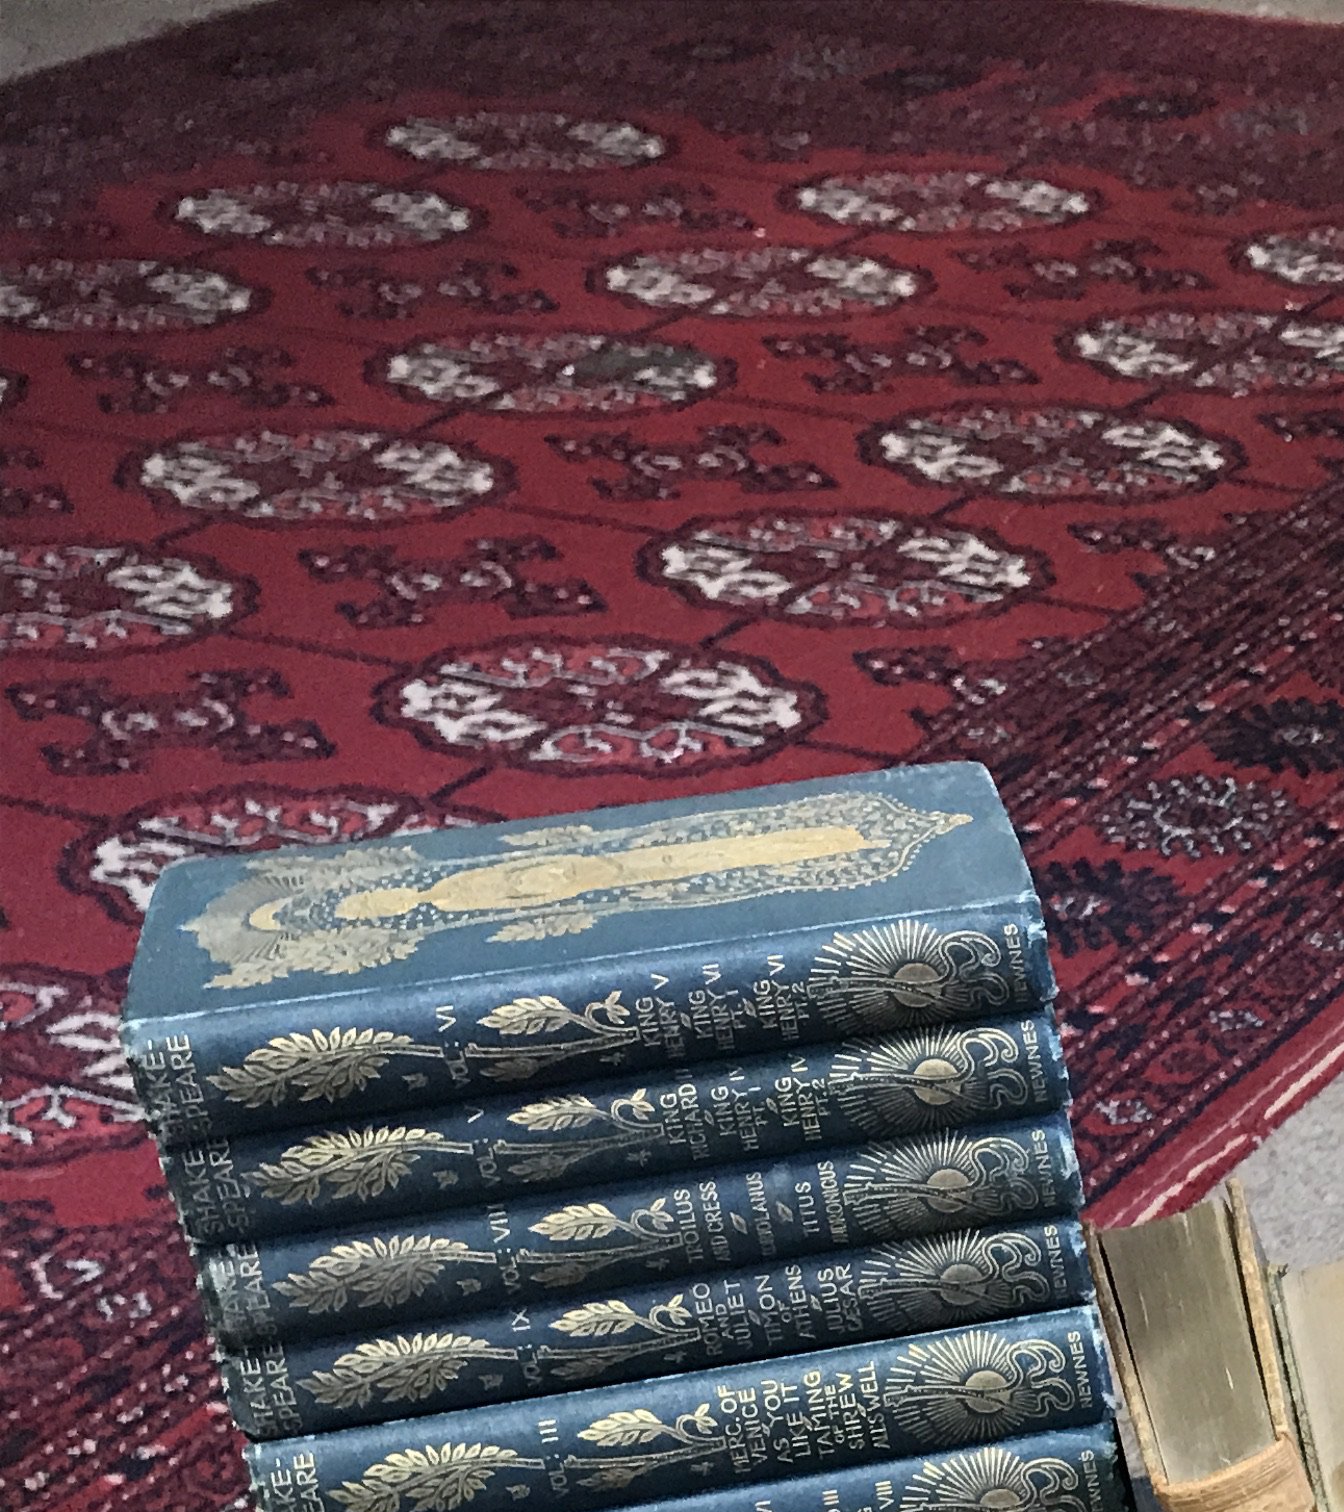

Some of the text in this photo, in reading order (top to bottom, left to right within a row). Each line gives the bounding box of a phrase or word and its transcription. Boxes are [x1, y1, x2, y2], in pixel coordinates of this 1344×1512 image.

[436, 1005, 457, 1031] VI
[636, 997, 660, 1047] KING
[650, 973, 686, 1058] HENRY V
[688, 990, 714, 1039] KING
[701, 963, 735, 1050] HENRY VI
[753, 979, 778, 1029] KING
[767, 954, 799, 1041] HENRY VI
[1020, 1020, 1048, 1102] NEWNES
[660, 1093, 686, 1144] KING
[711, 1085, 737, 1136] KING
[731, 1088, 759, 1151] HENRY
[775, 1077, 800, 1126] KING
[792, 1078, 822, 1140] HENRY
[674, 1188, 703, 1263] TROILUS
[795, 1181, 820, 1237] TITUS
[817, 1160, 848, 1243] ANDRONICUS
[510, 1307, 530, 1332] IX
[692, 1282, 722, 1356] ROMEO
[716, 1303, 734, 1340] AND
[724, 1280, 753, 1350] JULIET
[755, 1275, 783, 1346] TIMON
[777, 1300, 792, 1323] OF
[785, 1264, 816, 1340] ATHENS
[817, 1267, 845, 1334] JULIUS
[717, 1385, 738, 1413] OF
[857, 1360, 880, 1412] WELL
[1067, 1330, 1092, 1408] NEWNES
[539, 1419, 559, 1442] III
[736, 1387, 768, 1466] VENICE
[761, 1380, 794, 1463] AS YOU
[780, 1382, 811, 1457] LIKE IT
[803, 1369, 835, 1459] TAMING
[824, 1384, 843, 1444] OF THE
[836, 1372, 865, 1450] SHREW
[822, 1489, 840, 1506] III
[875, 1480, 895, 1510] VIII
